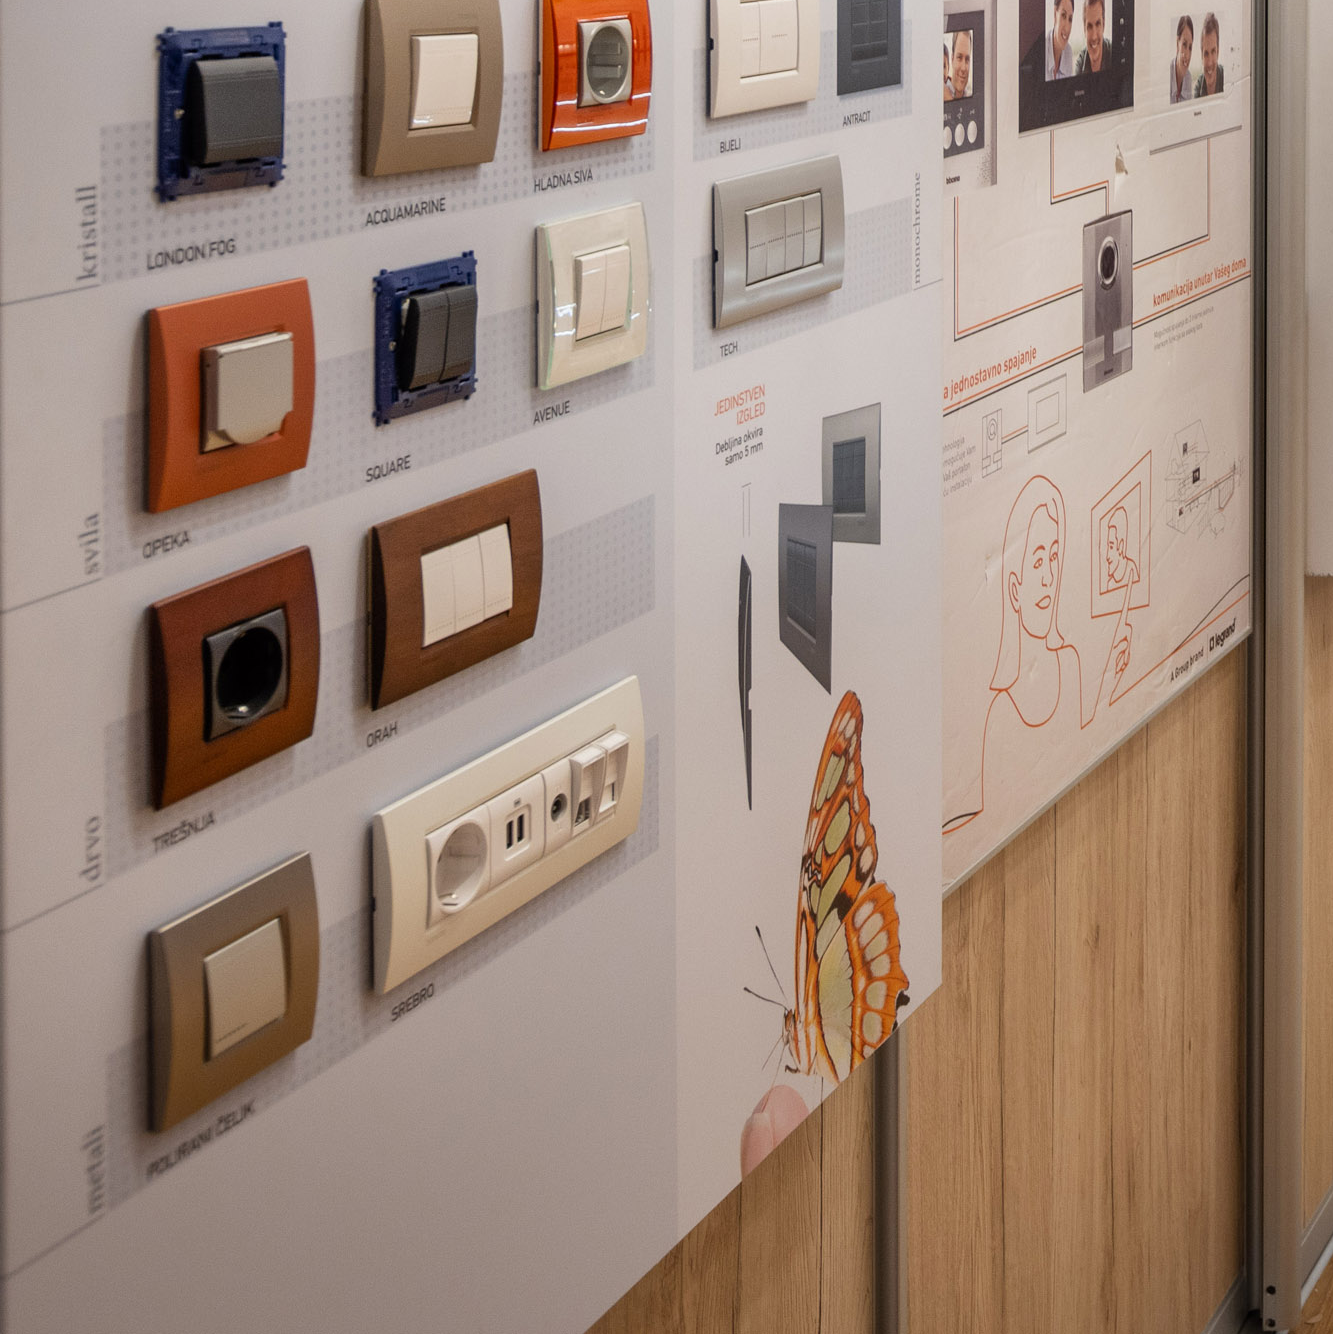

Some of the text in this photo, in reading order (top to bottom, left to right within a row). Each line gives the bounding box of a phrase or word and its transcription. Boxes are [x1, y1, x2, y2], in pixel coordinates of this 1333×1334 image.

[843, 111, 871, 127] ANTRACIT
[720, 139, 741, 154] BIJELI
[533, 169, 593, 193] HLADNA SIVA
[365, 198, 446, 226] ACQUAMARINE
[76, 185, 97, 282] kristall
[913, 172, 921, 284] monochrome
[147, 238, 236, 270] LONDON FOG
[1153, 279, 1193, 307] komunikacija
[1194, 272, 1213, 290] unutar
[1232, 258, 1247, 273] doma
[720, 341, 738, 357] TECH
[950, 362, 1002, 399] jednostavno
[1004, 345, 1037, 377] spajanje
[533, 400, 570, 424] AVENUE
[714, 384, 766, 417] JEDINSTVEN
[736, 401, 766, 426] IZGLED
[715, 426, 763, 456] Debljina okvira
[725, 450, 743, 466] samo
[750, 442, 763, 454] mm
[366, 455, 411, 483] SQUARE
[78, 513, 99, 576] svila
[143, 530, 191, 559] OPEKA
[367, 722, 398, 748] ORAH
[152, 811, 215, 853] TREŠNJA
[80, 817, 101, 882] drvo
[390, 983, 435, 1021] SREBRO
[81, 1125, 105, 1215] metali
